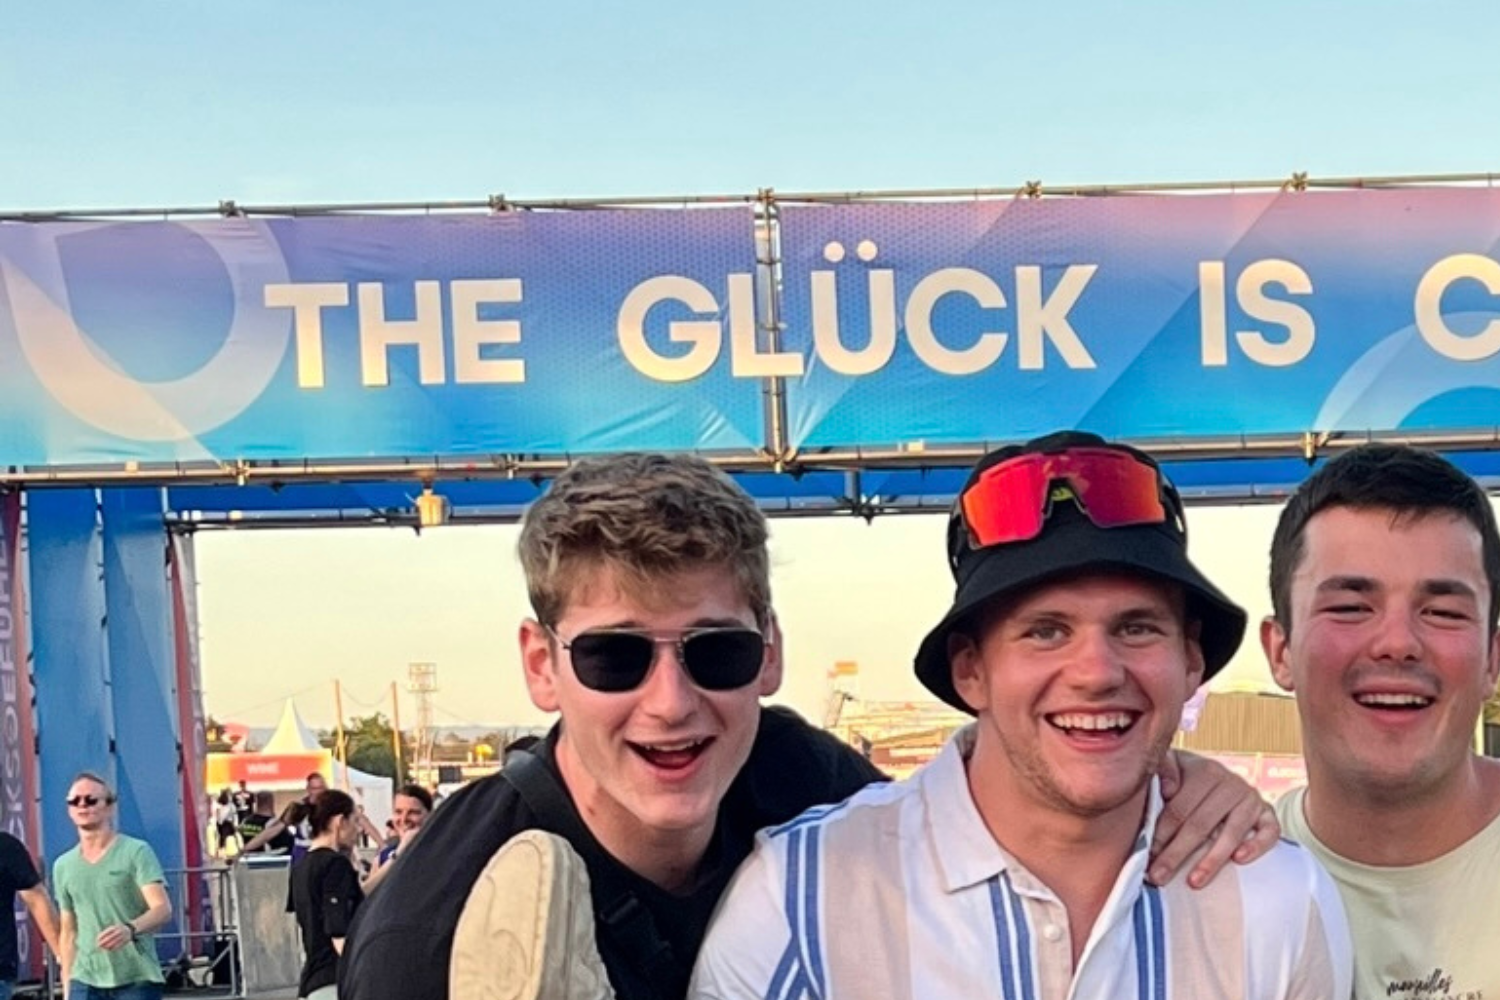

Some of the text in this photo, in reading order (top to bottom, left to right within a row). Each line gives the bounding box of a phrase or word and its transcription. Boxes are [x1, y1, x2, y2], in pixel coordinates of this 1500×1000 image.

[264, 278, 525, 388] THE
[617, 239, 1098, 382] GLÜCK
[1199, 258, 1315, 367] IS
